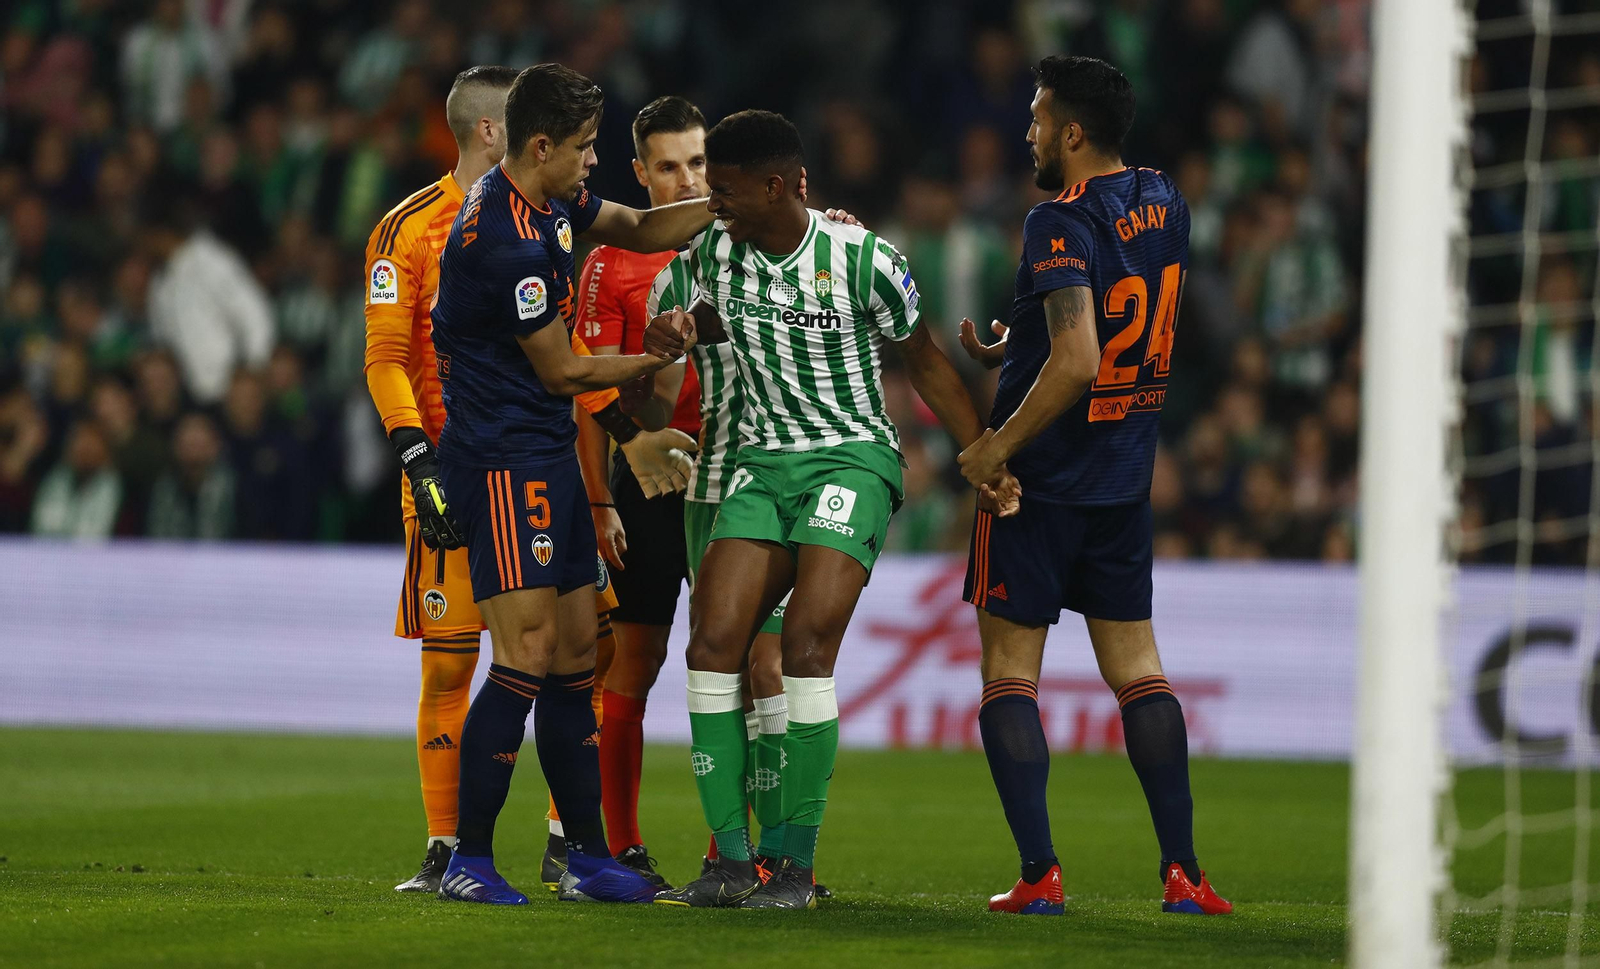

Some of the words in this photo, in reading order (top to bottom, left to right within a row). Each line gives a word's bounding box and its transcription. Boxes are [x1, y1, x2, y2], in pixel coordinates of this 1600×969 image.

[1032, 255, 1087, 273] sesderma
[372, 290, 395, 300] LaLiga
[520, 302, 545, 315] LaLiga
[1091, 262, 1181, 392] 24
[403, 446, 428, 465] JAUME
[524, 481, 552, 530] 5
[808, 517, 855, 538] BESOCCER
[423, 743, 458, 751] adidas
